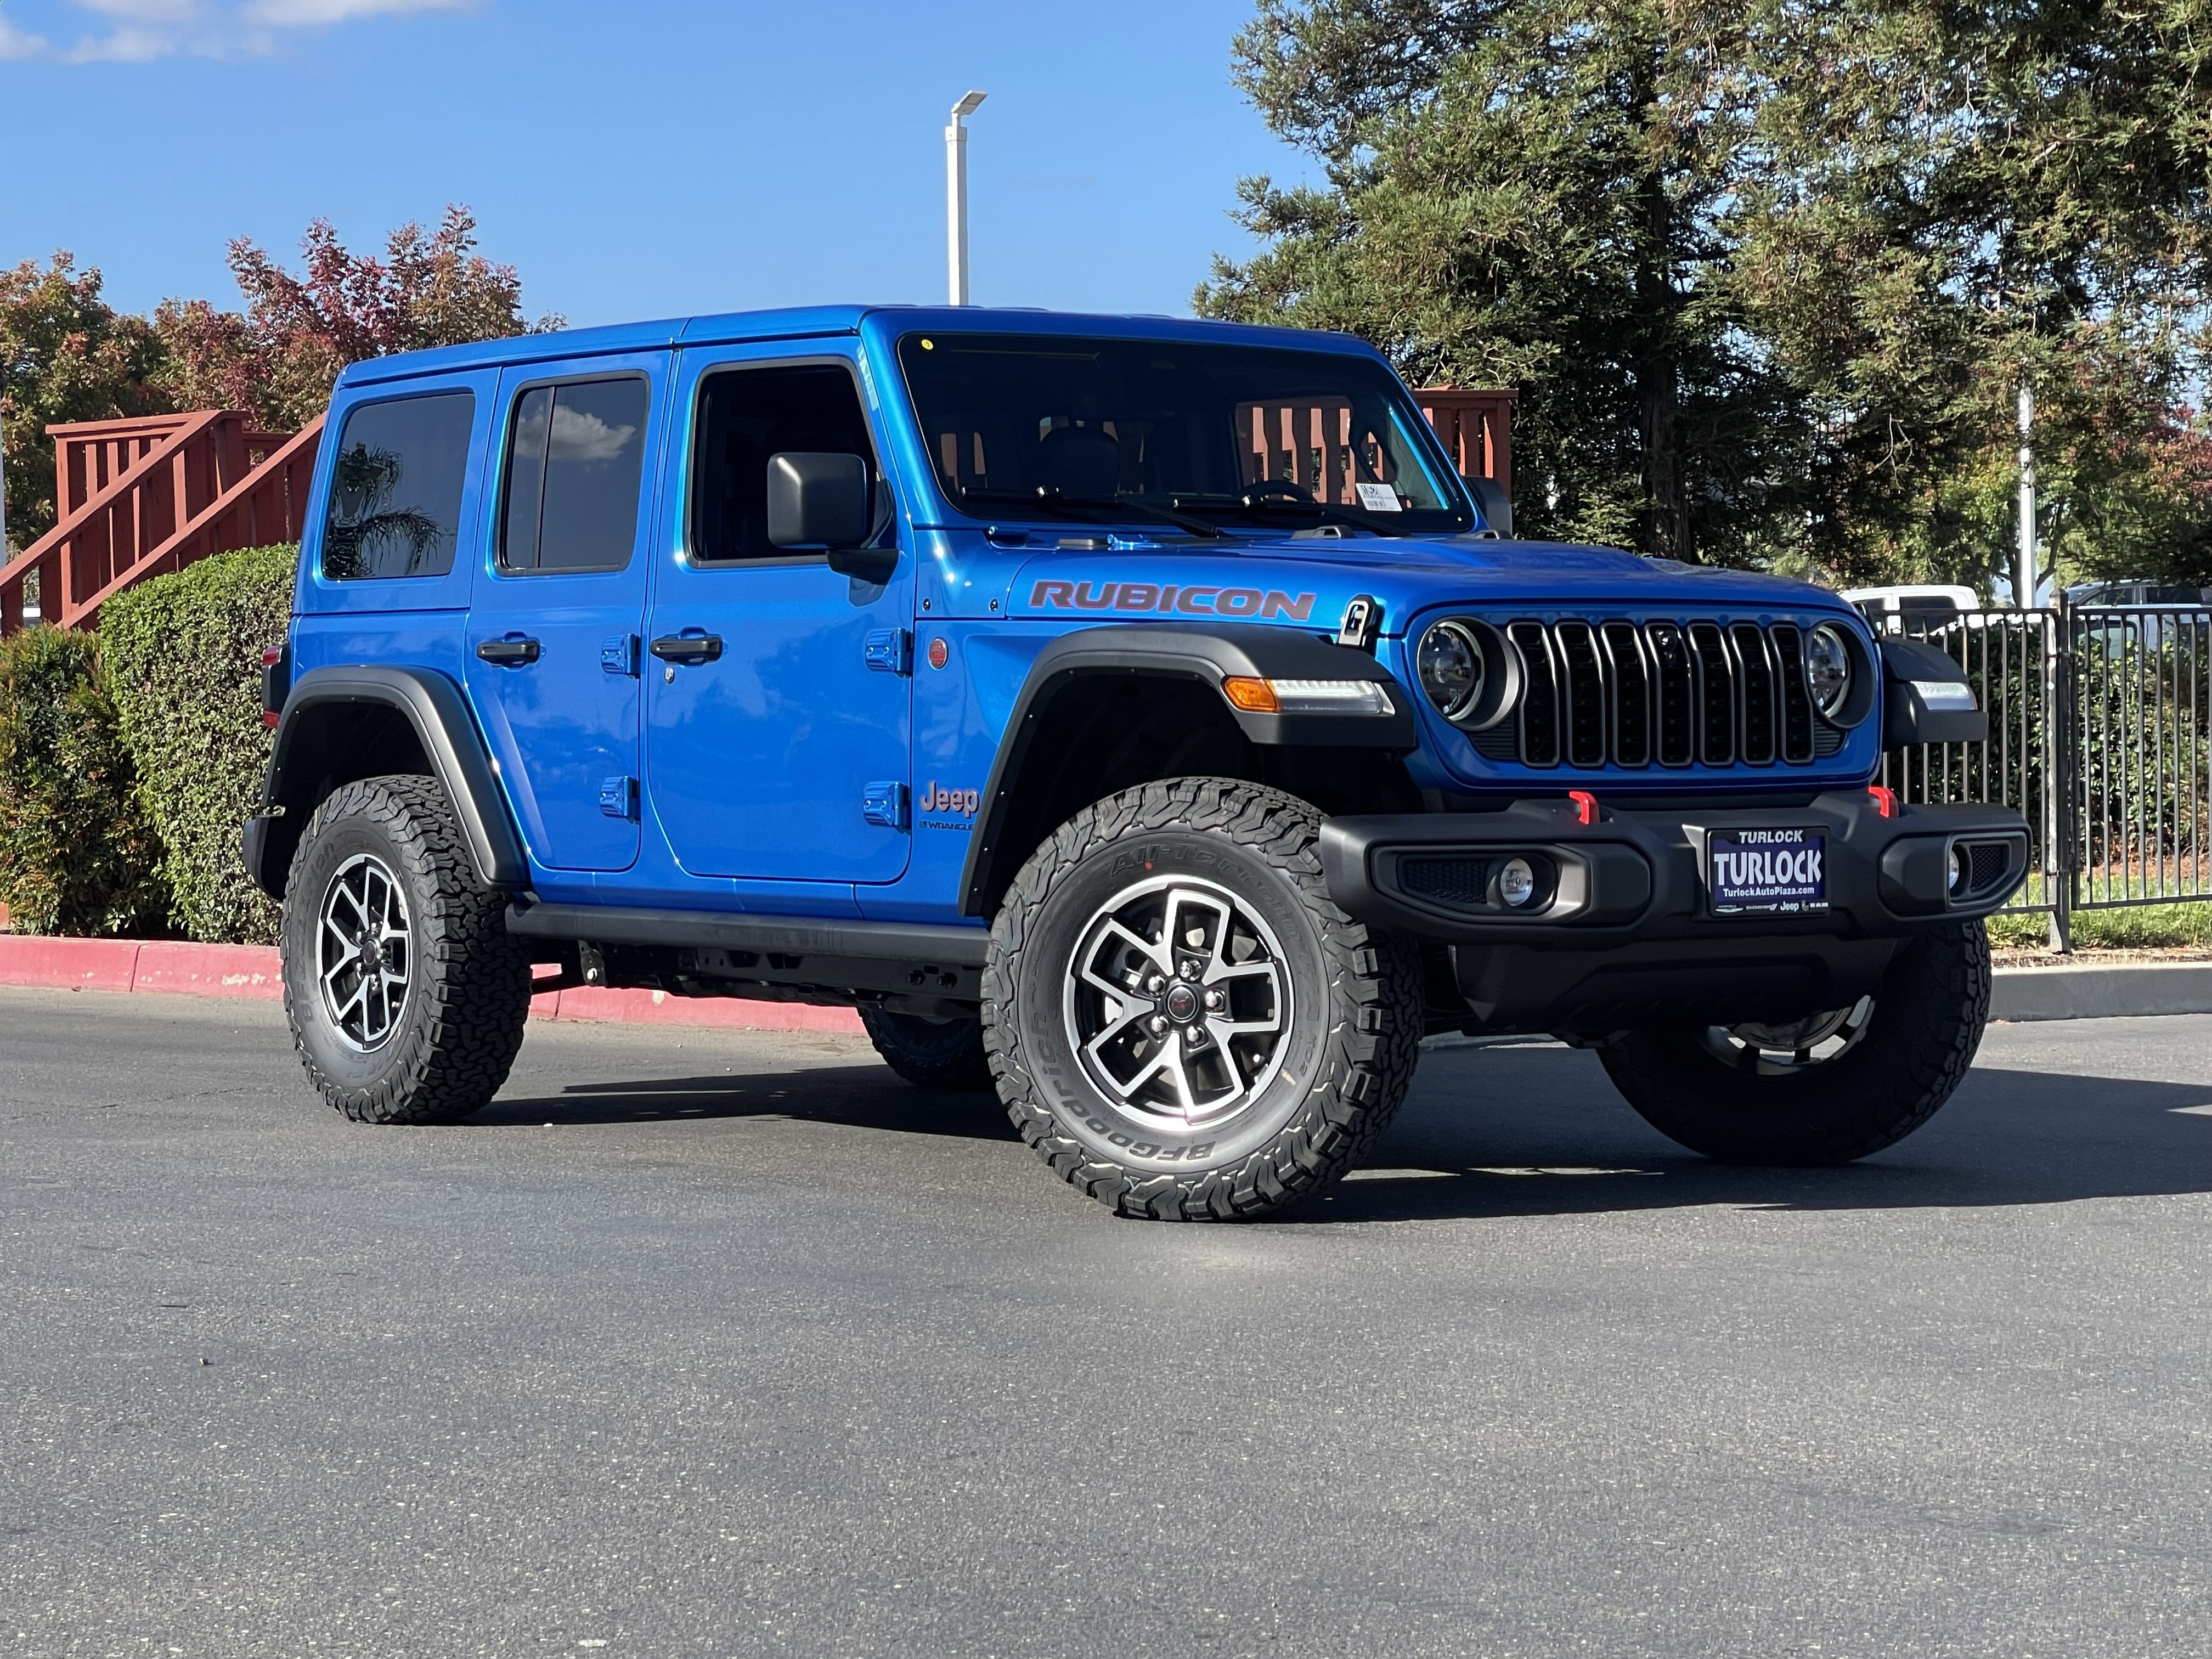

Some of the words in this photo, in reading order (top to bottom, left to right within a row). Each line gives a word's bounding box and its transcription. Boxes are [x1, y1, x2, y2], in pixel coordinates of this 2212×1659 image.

[1030, 580, 1316, 620] RUBICON
[921, 781, 979, 819] Jeep
[928, 821, 975, 831] WRANGLE
[1739, 830, 1803, 844] TURLOCK
[1714, 850, 1821, 885] TURLOCK
[1110, 842, 1302, 941] All-Terrain
[1723, 886, 1814, 898] TurlockAutoPlaza.com
[1780, 901, 1799, 912] Jeep
[1029, 1012, 1216, 1161] BFGoodrich
